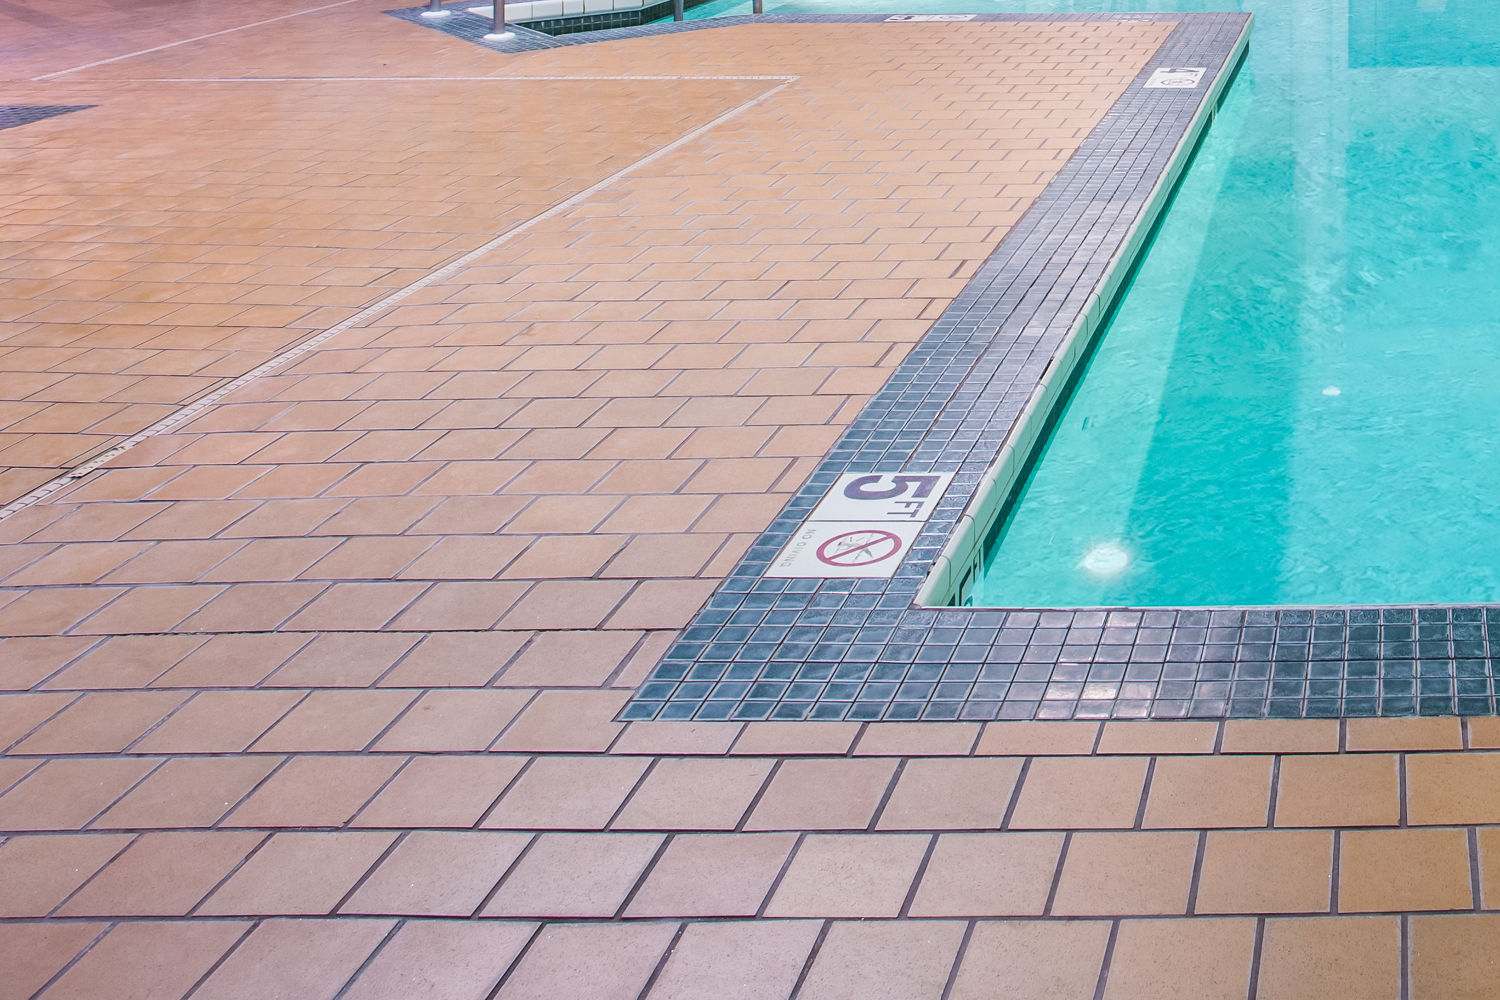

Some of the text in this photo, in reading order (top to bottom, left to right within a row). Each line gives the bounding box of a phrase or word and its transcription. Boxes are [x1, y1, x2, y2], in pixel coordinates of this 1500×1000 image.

[844, 474, 942, 518] 5 FT
[780, 529, 816, 567] NO DIVING
